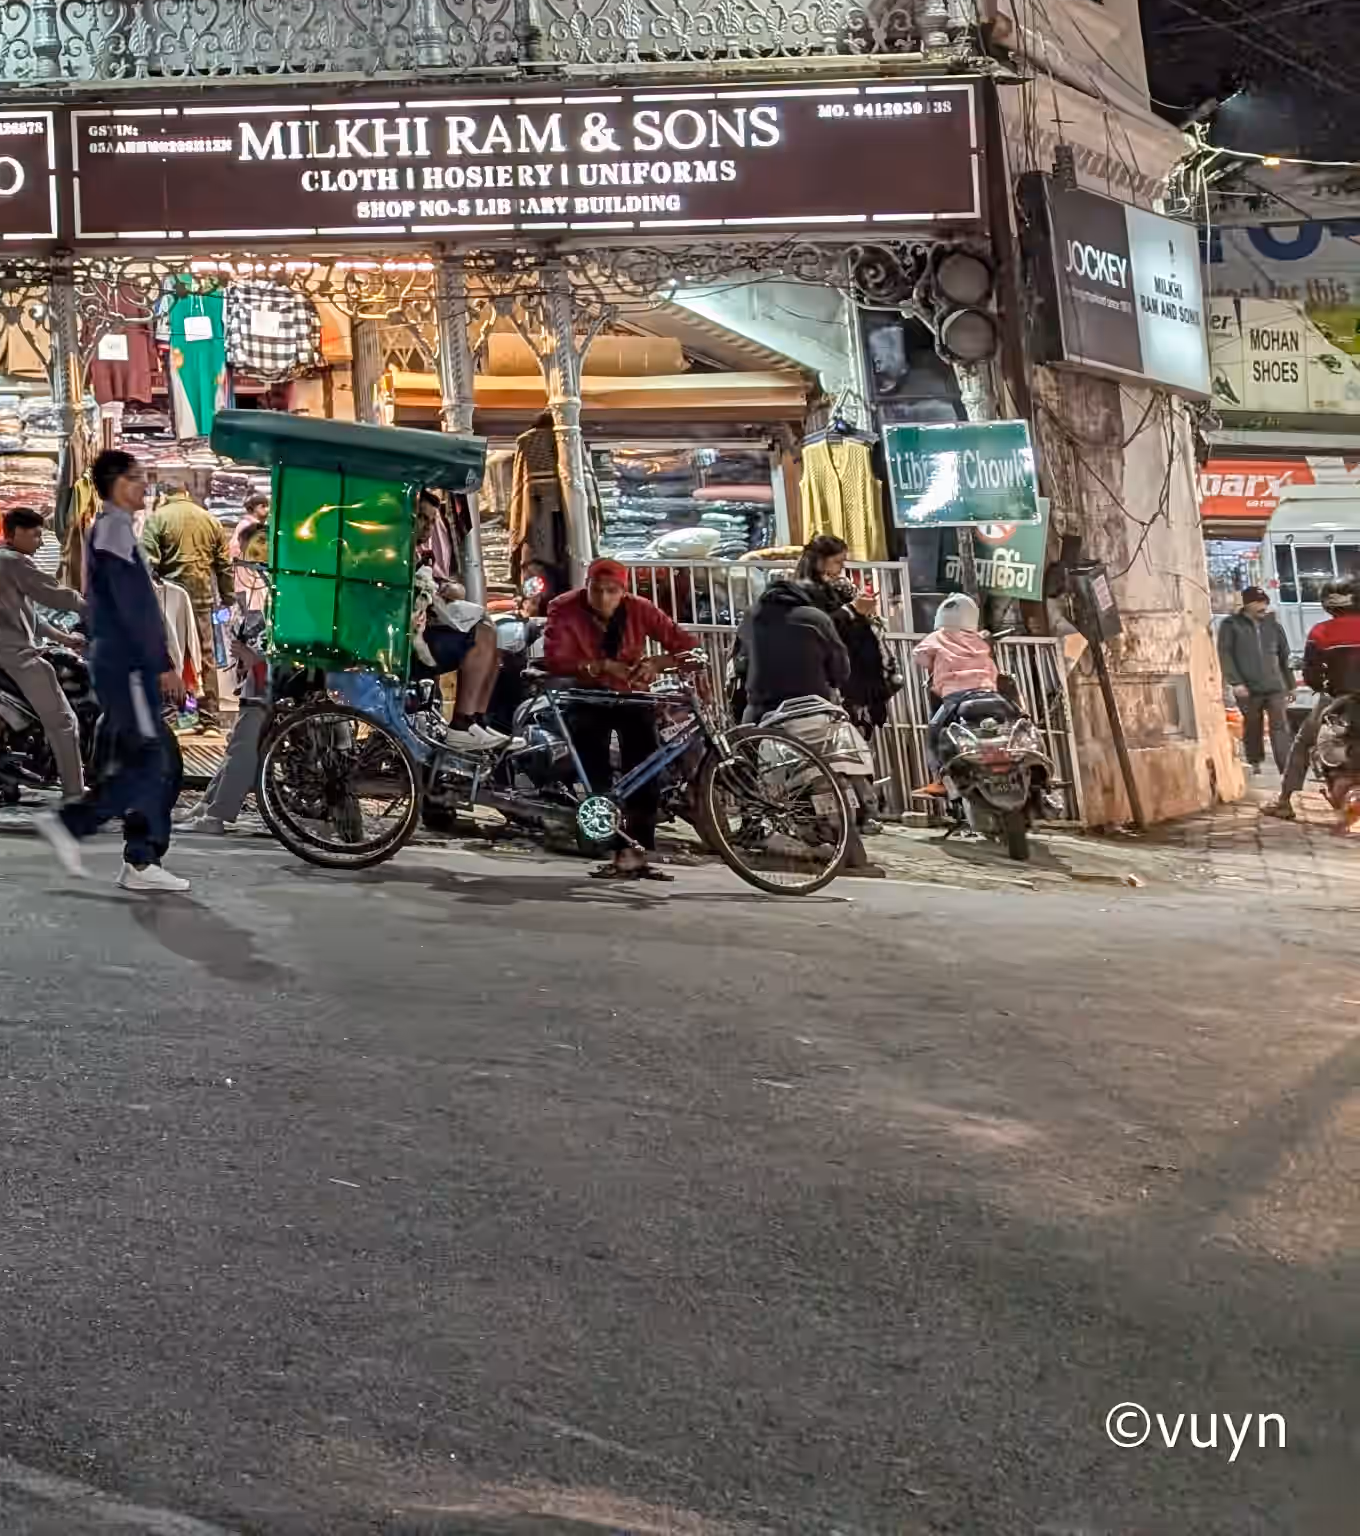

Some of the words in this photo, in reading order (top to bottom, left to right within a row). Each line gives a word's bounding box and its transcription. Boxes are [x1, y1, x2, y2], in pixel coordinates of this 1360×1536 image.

[237, 116, 431, 161] MILKHI
[445, 113, 568, 157] RAM
[579, 111, 621, 153] &
[633, 105, 781, 151] SONS
[301, 168, 399, 192] CLOTH
[422, 164, 551, 190] HOSIERY
[577, 159, 737, 187] UNIFORMS
[357, 199, 415, 219] SHOP
[474, 197, 568, 217] LIBRARY
[574, 194, 682, 214] BUILDING
[1065, 239, 1127, 289] JOCKEY
[1154, 275, 1183, 300] MILKHI
[1161, 301, 1178, 321] AND
[1249, 328, 1299, 352] MOHAN
[1252, 360, 1299, 384] SHOES
[896, 450, 959, 495] Libr
[963, 448, 1028, 489] Chowk
